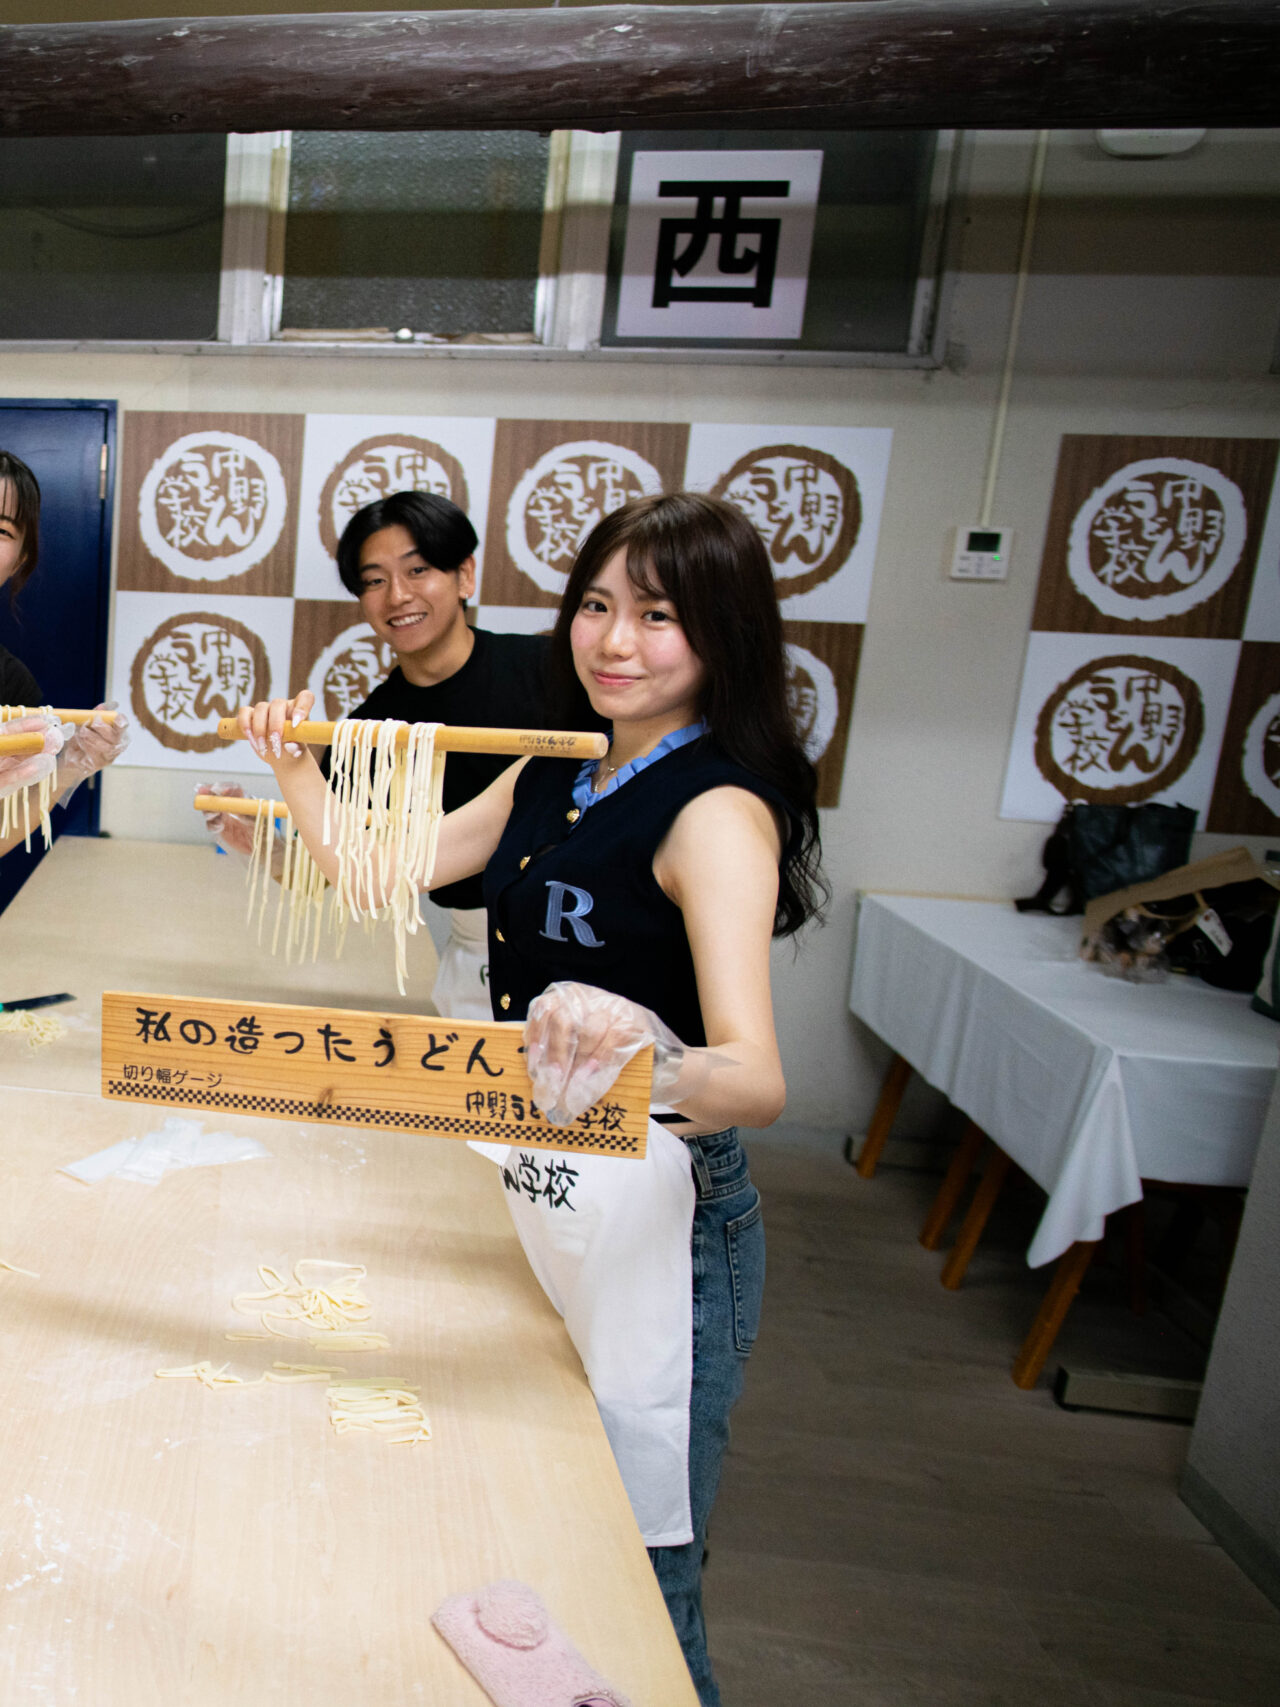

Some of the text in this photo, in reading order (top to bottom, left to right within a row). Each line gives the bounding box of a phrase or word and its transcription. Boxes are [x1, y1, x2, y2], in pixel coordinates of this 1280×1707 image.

[651, 180, 791, 309] 西
[538, 880, 606, 948] R
[122, 1063, 223, 1089] 切り幅ゲージ
[135, 1006, 528, 1078] 私の造ったうどん
[466, 1089, 628, 1133] 中野うど学校
